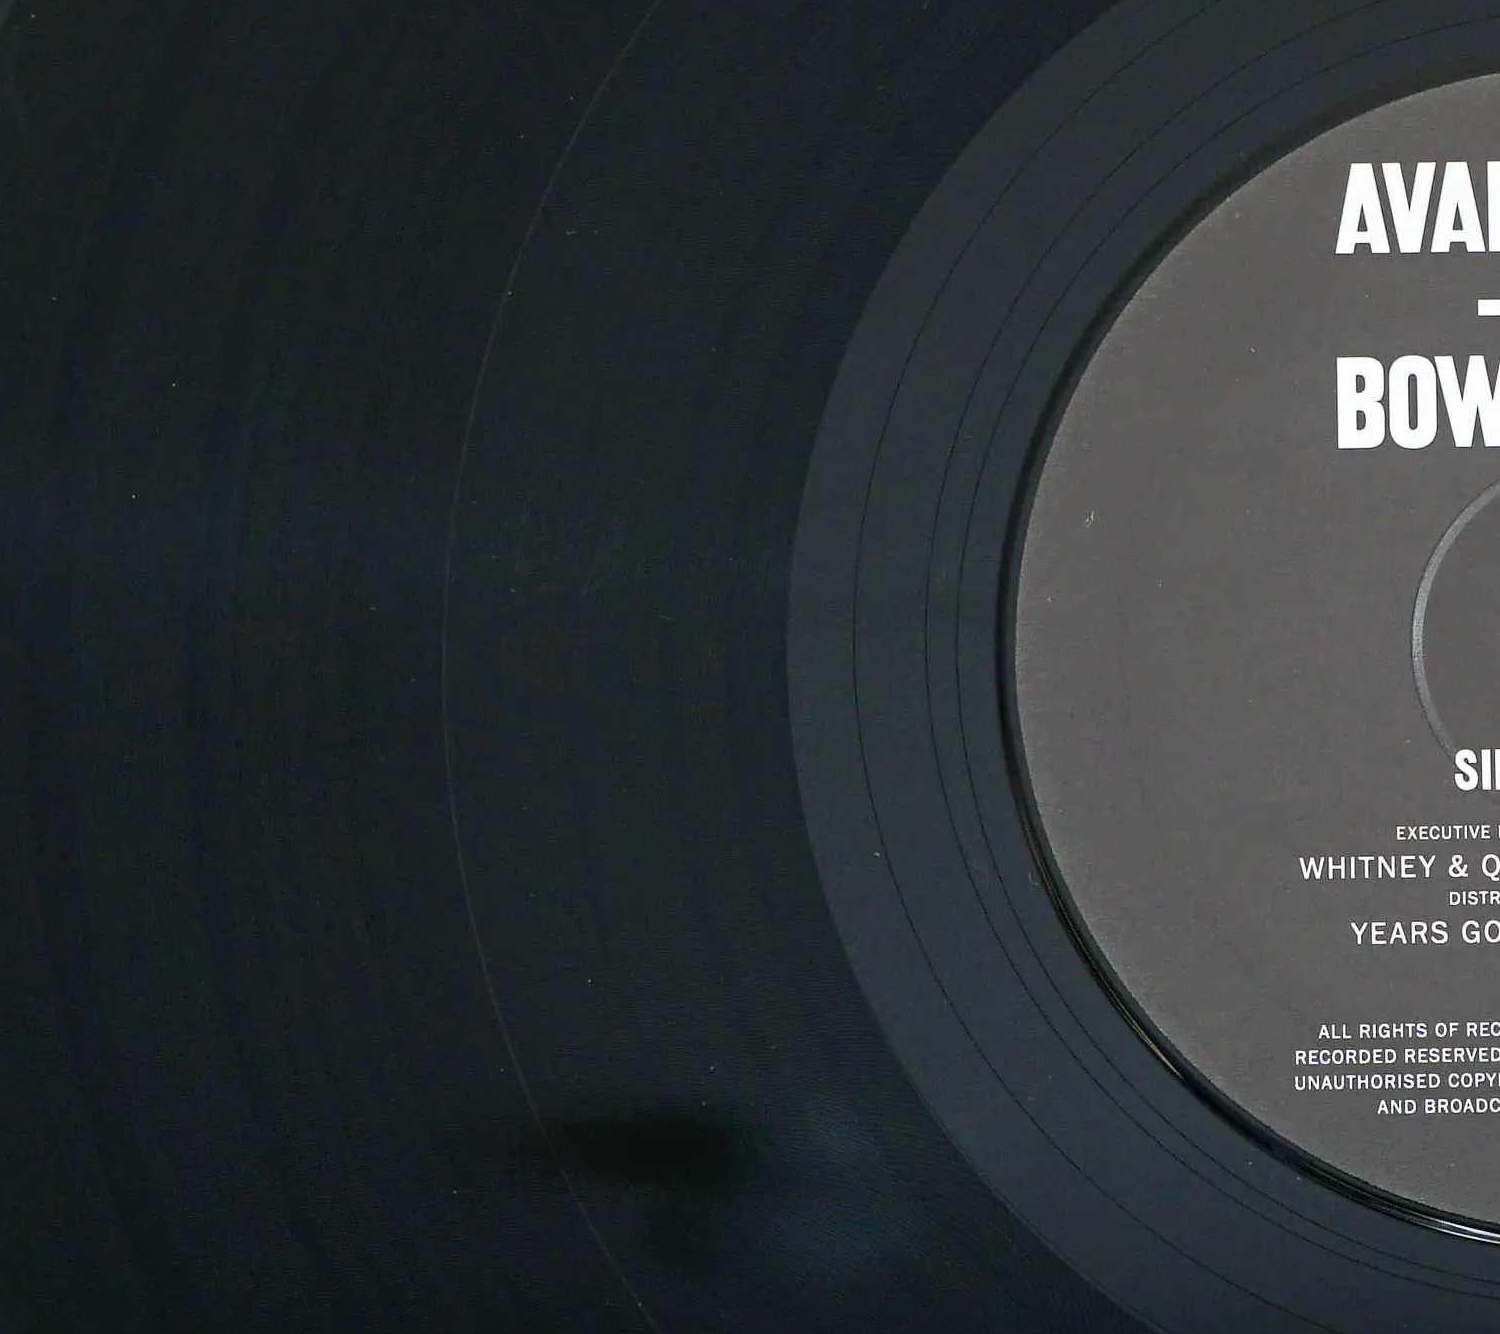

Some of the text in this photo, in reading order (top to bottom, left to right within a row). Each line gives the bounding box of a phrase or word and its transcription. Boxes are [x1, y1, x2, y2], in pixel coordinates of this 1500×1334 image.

[1396, 824, 1491, 841] EXECUTIVE
[1298, 854, 1437, 880] WHITNEY
[1448, 854, 1469, 878] &
[1350, 920, 1449, 945] YEARS
[1318, 1023, 1352, 1040] ALL
[1359, 1022, 1428, 1039] RIGHTS
[1434, 1022, 1459, 1038] OF
[1295, 1048, 1397, 1066] RECORDED
[1294, 1073, 1441, 1091] UNAUTHORISED
[1377, 1099, 1417, 1115] AND
